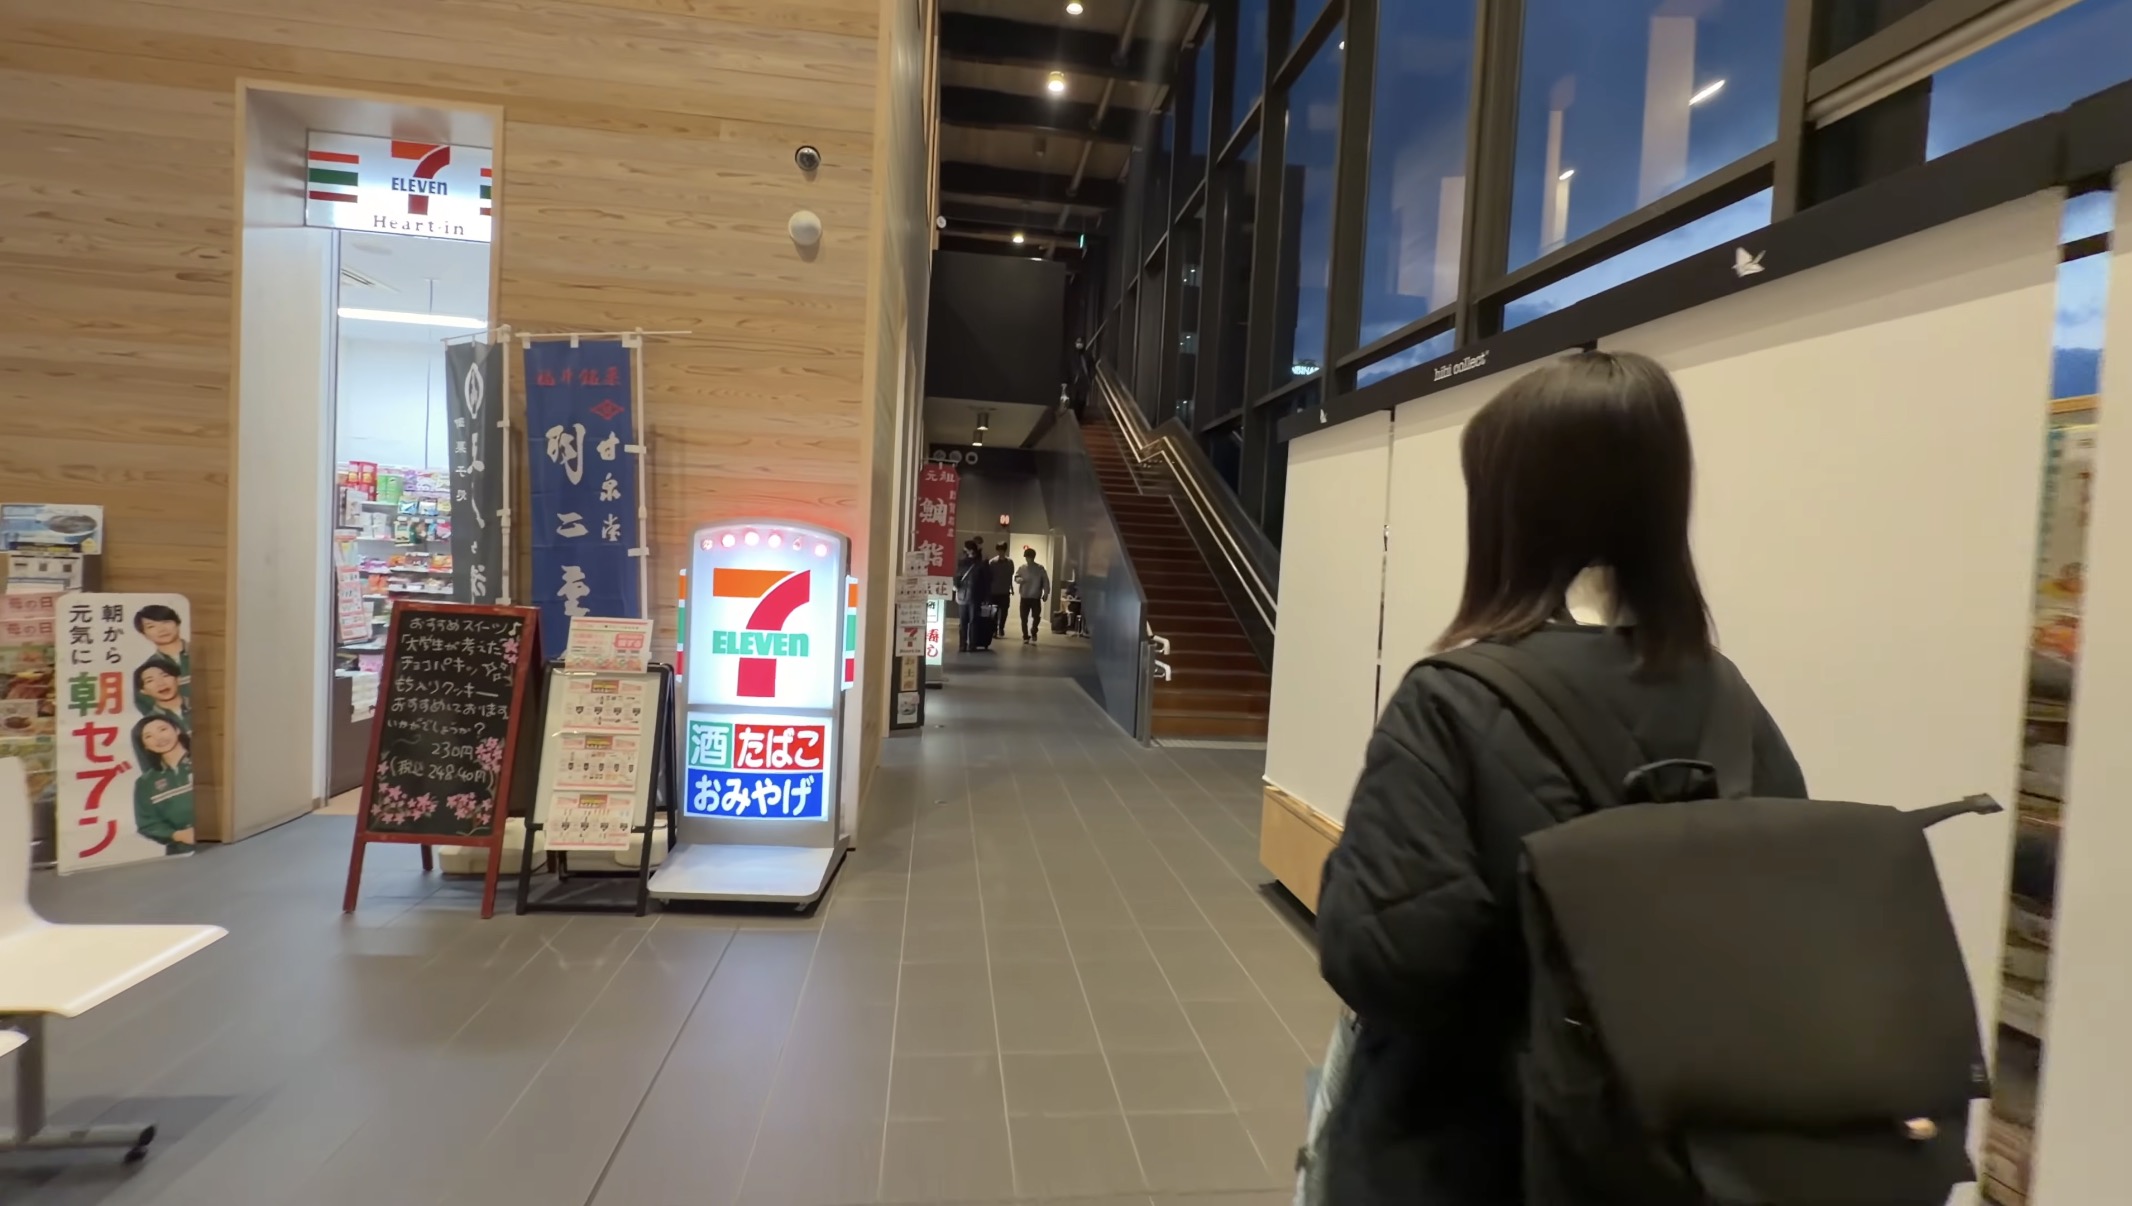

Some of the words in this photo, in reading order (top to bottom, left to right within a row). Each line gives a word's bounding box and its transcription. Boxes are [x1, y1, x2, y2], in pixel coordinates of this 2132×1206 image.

[391, 140, 450, 215] 7
[596, 430, 621, 542] 甘泉堂
[925, 470, 956, 483] 元祖
[69, 604, 94, 665] 元気に
[102, 604, 124, 665] 朝から
[713, 568, 810, 697] 7
[394, 675, 499, 698] もち入りクッキー
[67, 671, 132, 858] 朝セブン
[431, 742, 474, 760] 230円
[690, 724, 729, 766] 酒
[737, 727, 821, 769] たばこ
[694, 774, 816, 816] おみやげ
